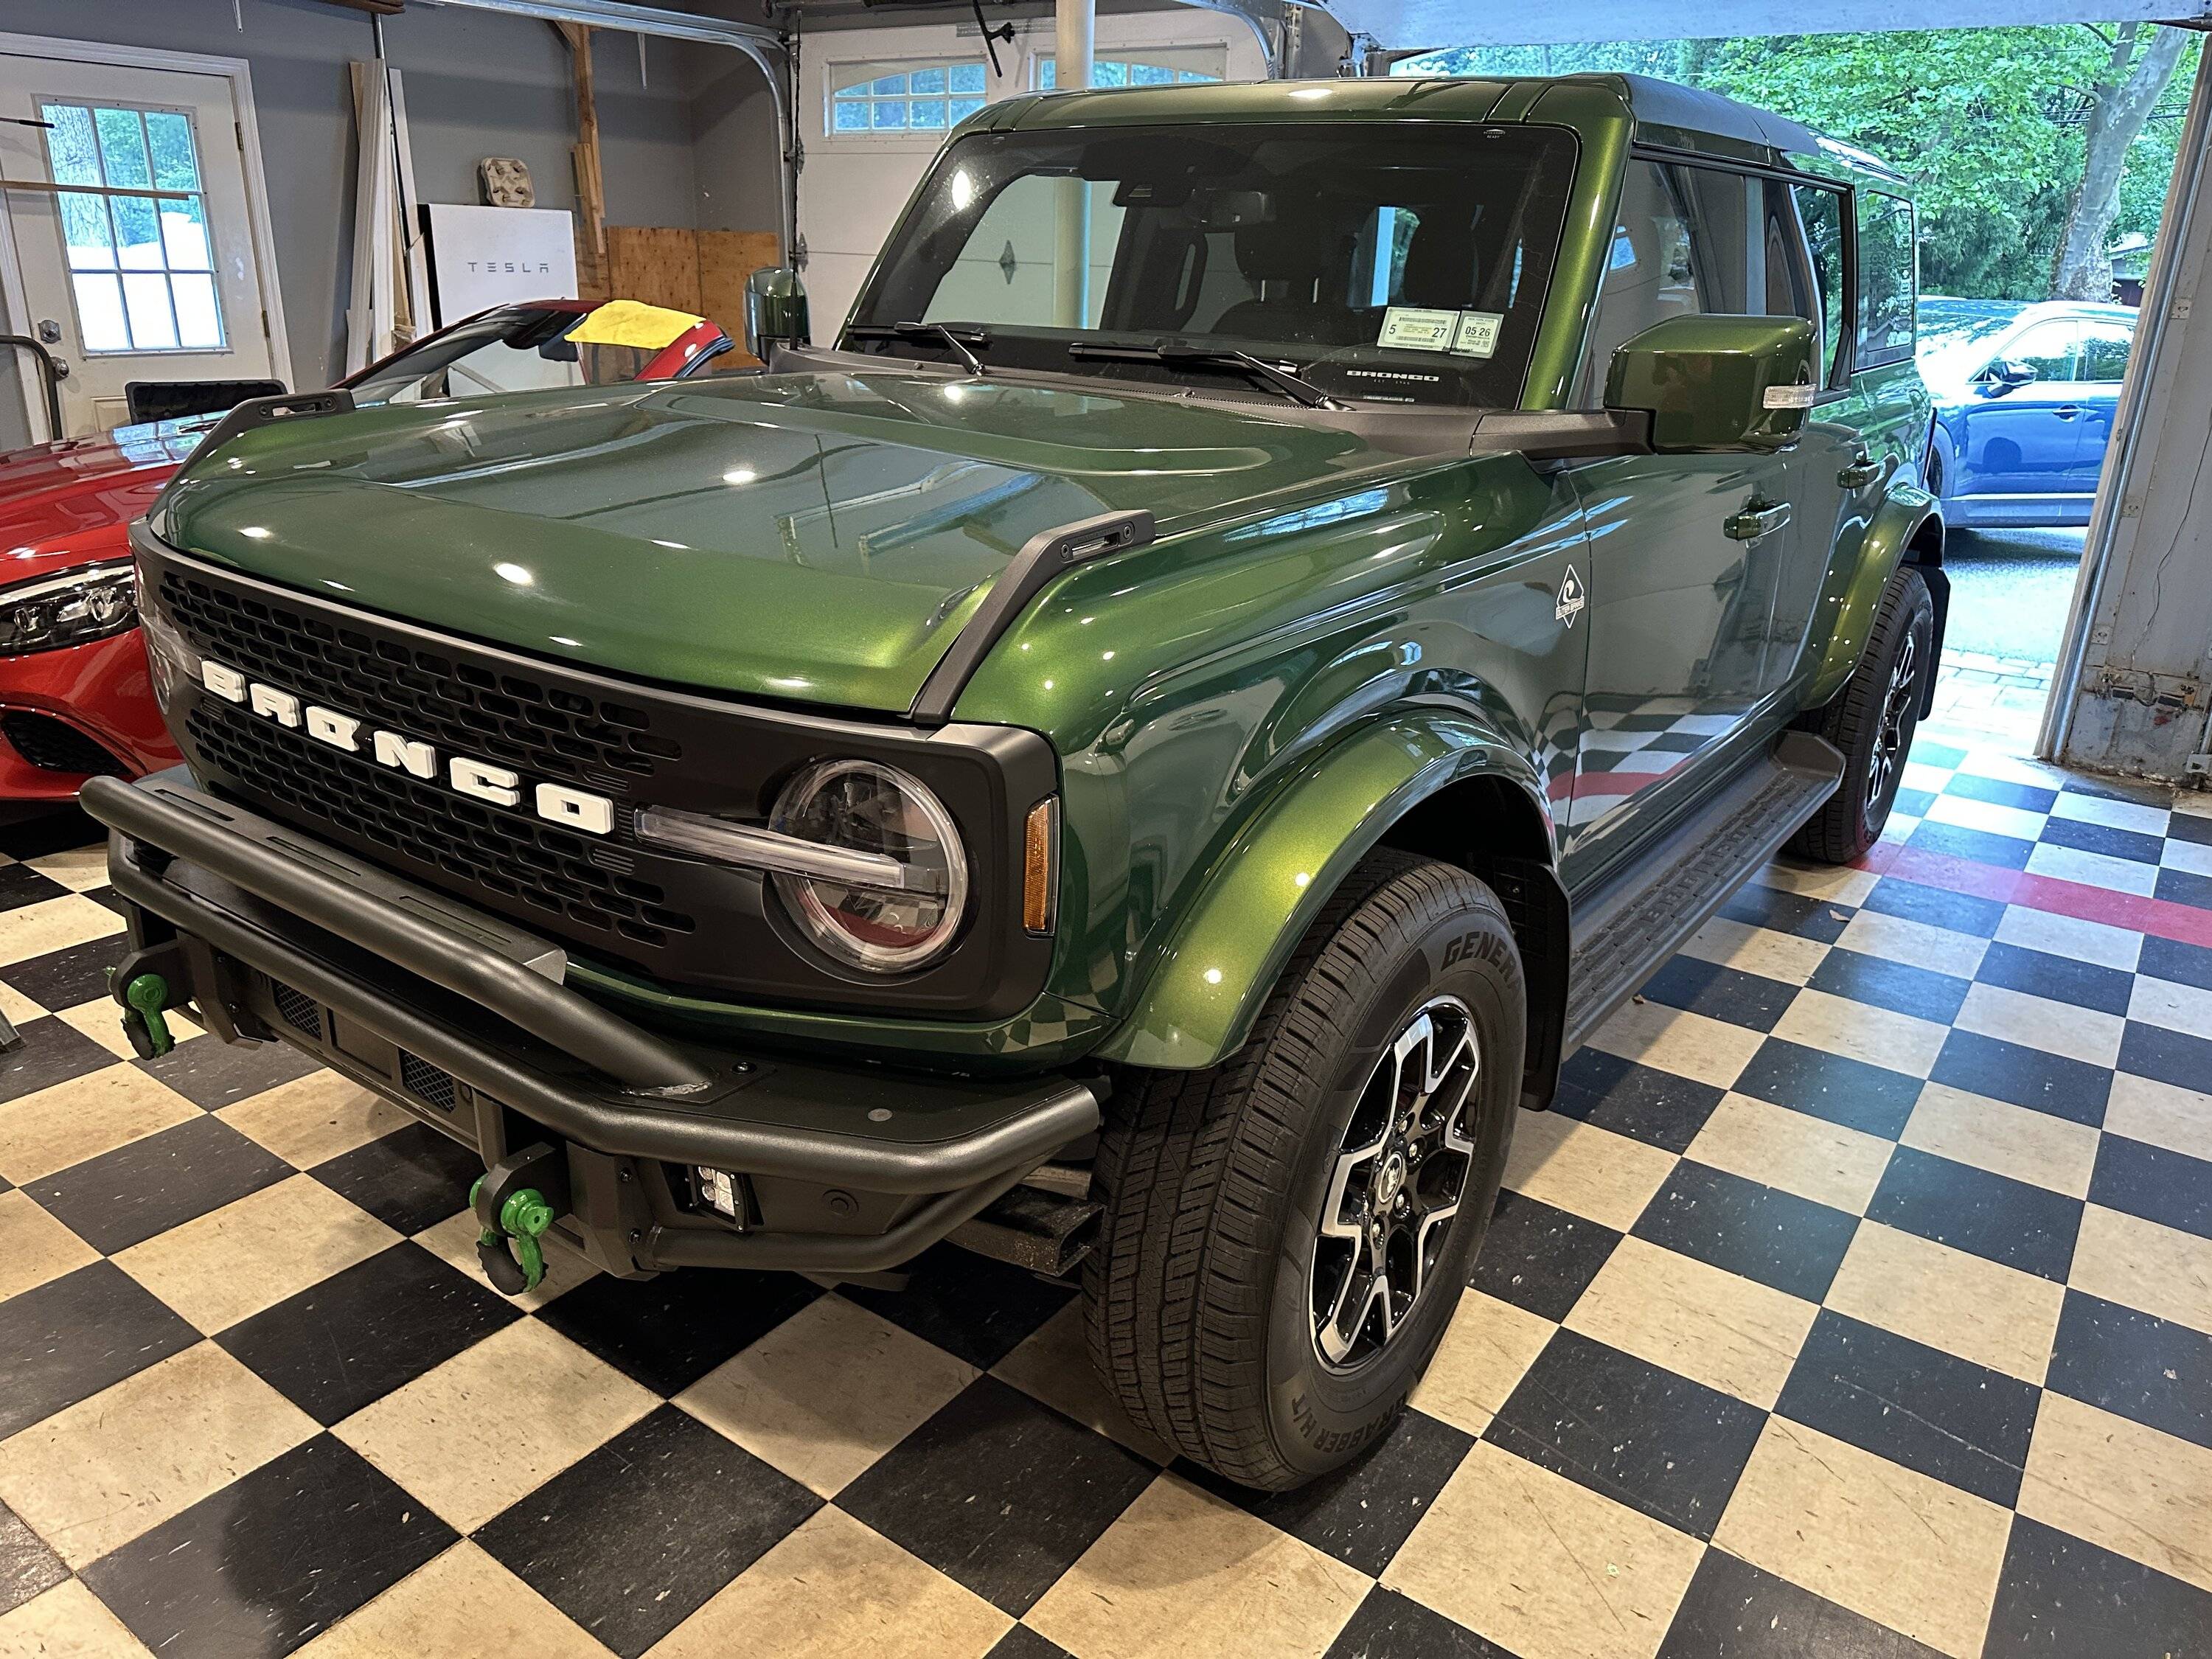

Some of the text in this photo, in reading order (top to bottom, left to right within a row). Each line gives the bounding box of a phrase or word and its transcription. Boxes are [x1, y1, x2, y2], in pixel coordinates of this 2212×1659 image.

[467, 262, 549, 273] TESLA
[1388, 324, 1397, 334] 5
[1431, 327, 1447, 338] 27
[1465, 326, 1491, 336] 05 26
[1346, 370, 1439, 382] BRONCO
[201, 660, 615, 835] BRONCO
[1441, 931, 1522, 989] GENERA
